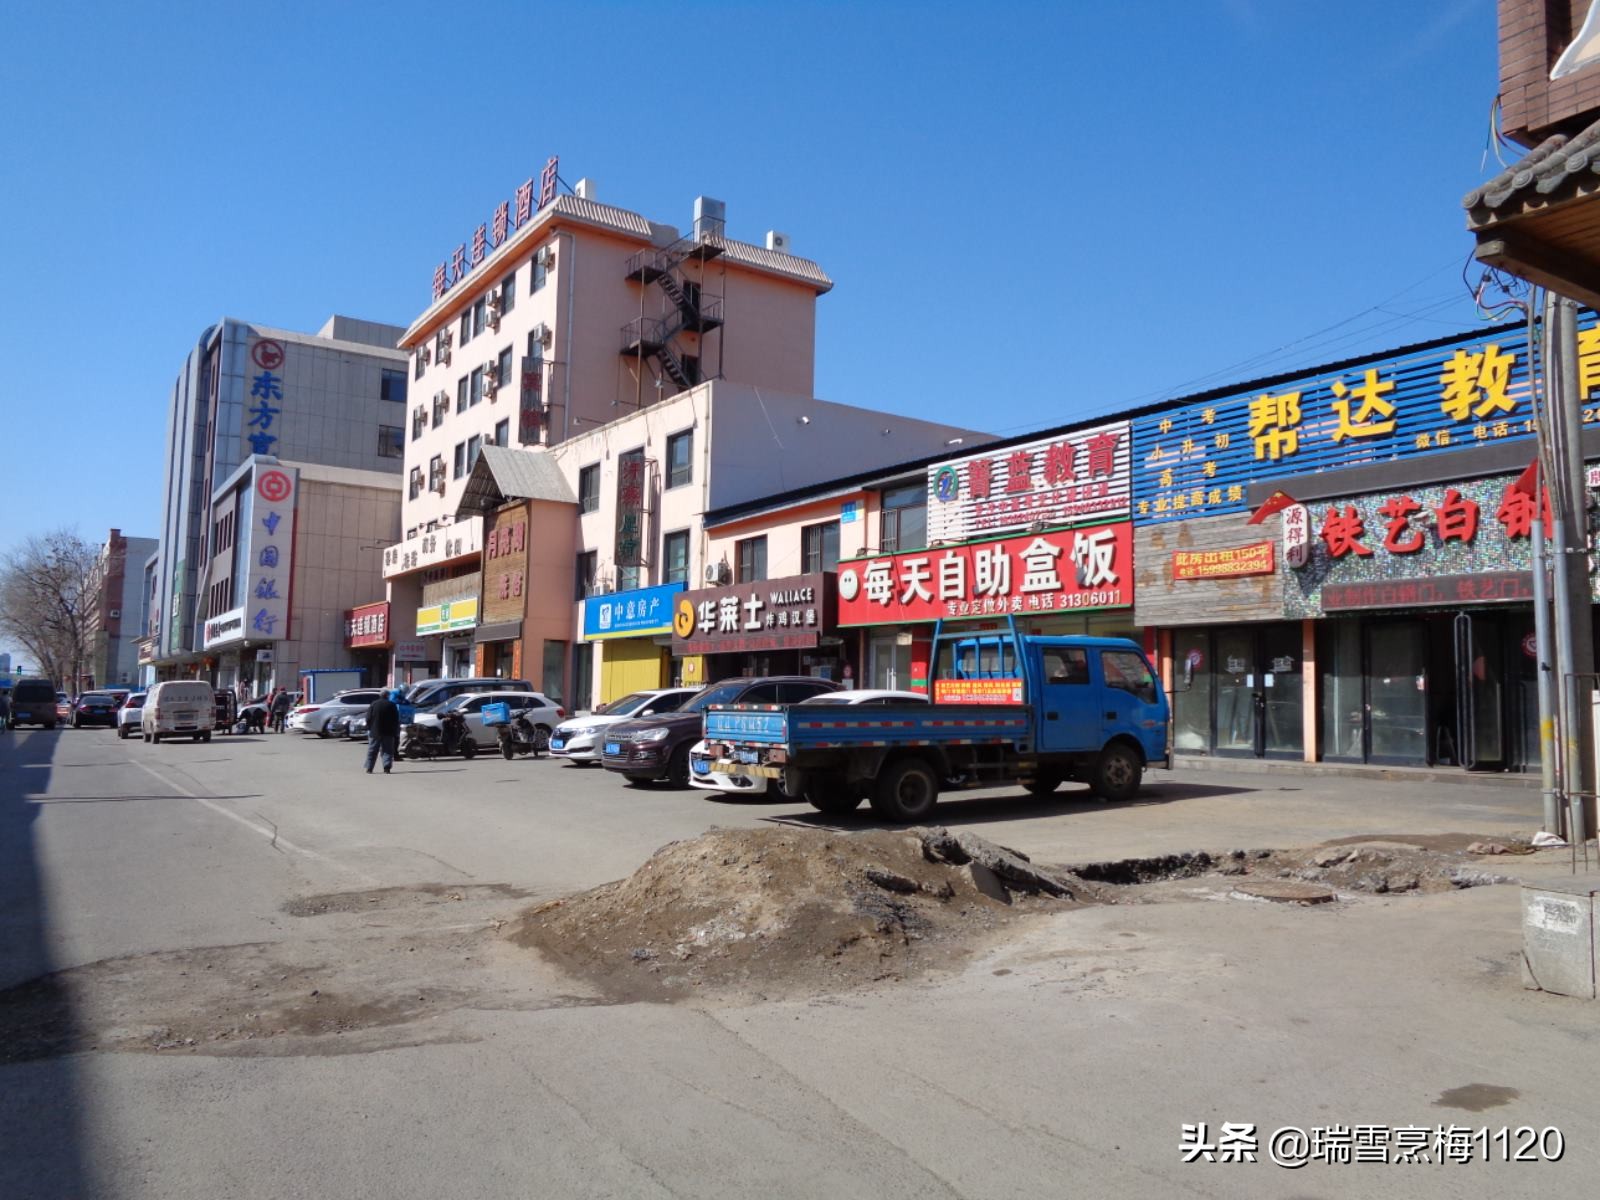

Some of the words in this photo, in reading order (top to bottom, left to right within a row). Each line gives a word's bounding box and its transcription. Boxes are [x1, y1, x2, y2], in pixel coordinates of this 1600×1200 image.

[1158, 408, 1217, 435] 中考
[1151, 433, 1230, 462] 小升初
[1159, 461, 1217, 488] 高考
[252, 511, 282, 636] 中国银行
[862, 528, 1120, 606] 每天自助盒饭
[769, 587, 812, 605] WALLACE
[947, 594, 1023, 616] 专业定做外卖
[1028, 592, 1054, 610] 电话
[1060, 590, 1121, 608] 31306011
[697, 592, 764, 634] 华莱士
[766, 609, 817, 628] 炸鸡汉堡
